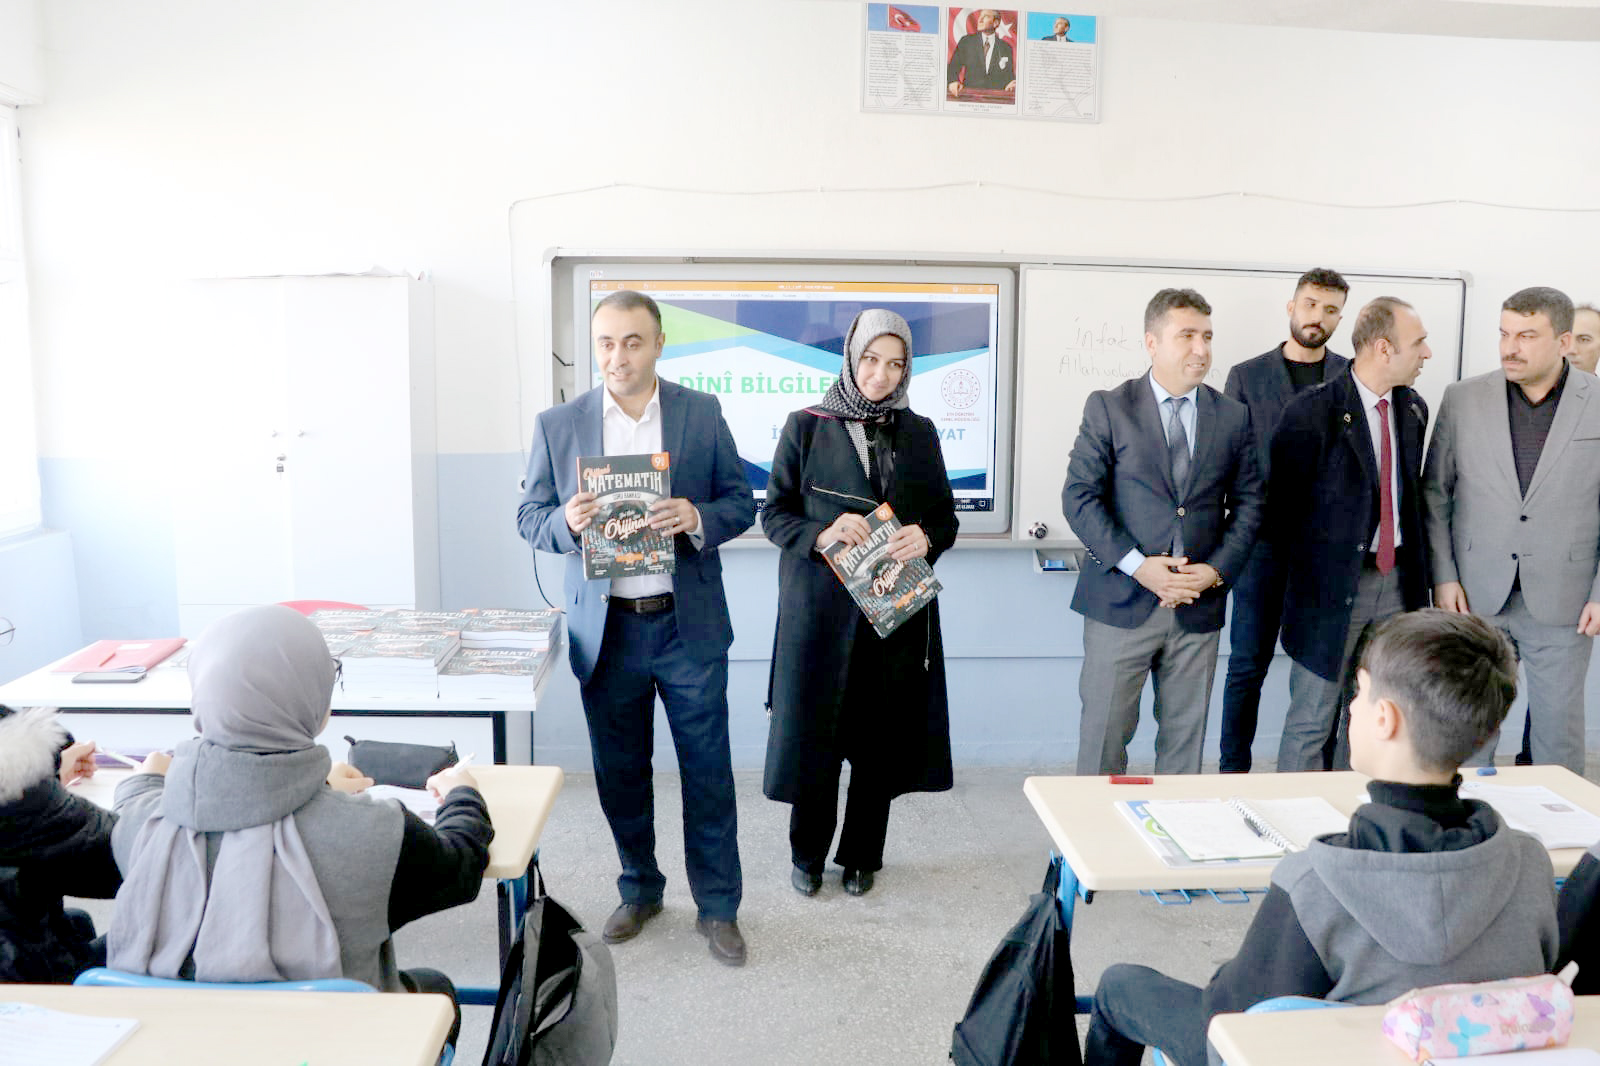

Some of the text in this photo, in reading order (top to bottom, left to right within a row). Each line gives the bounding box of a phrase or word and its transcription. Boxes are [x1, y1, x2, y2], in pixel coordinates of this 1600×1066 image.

[679, 371, 839, 394] DİNÎ BİLGİLE
[587, 471, 663, 495] MATEMATİK
